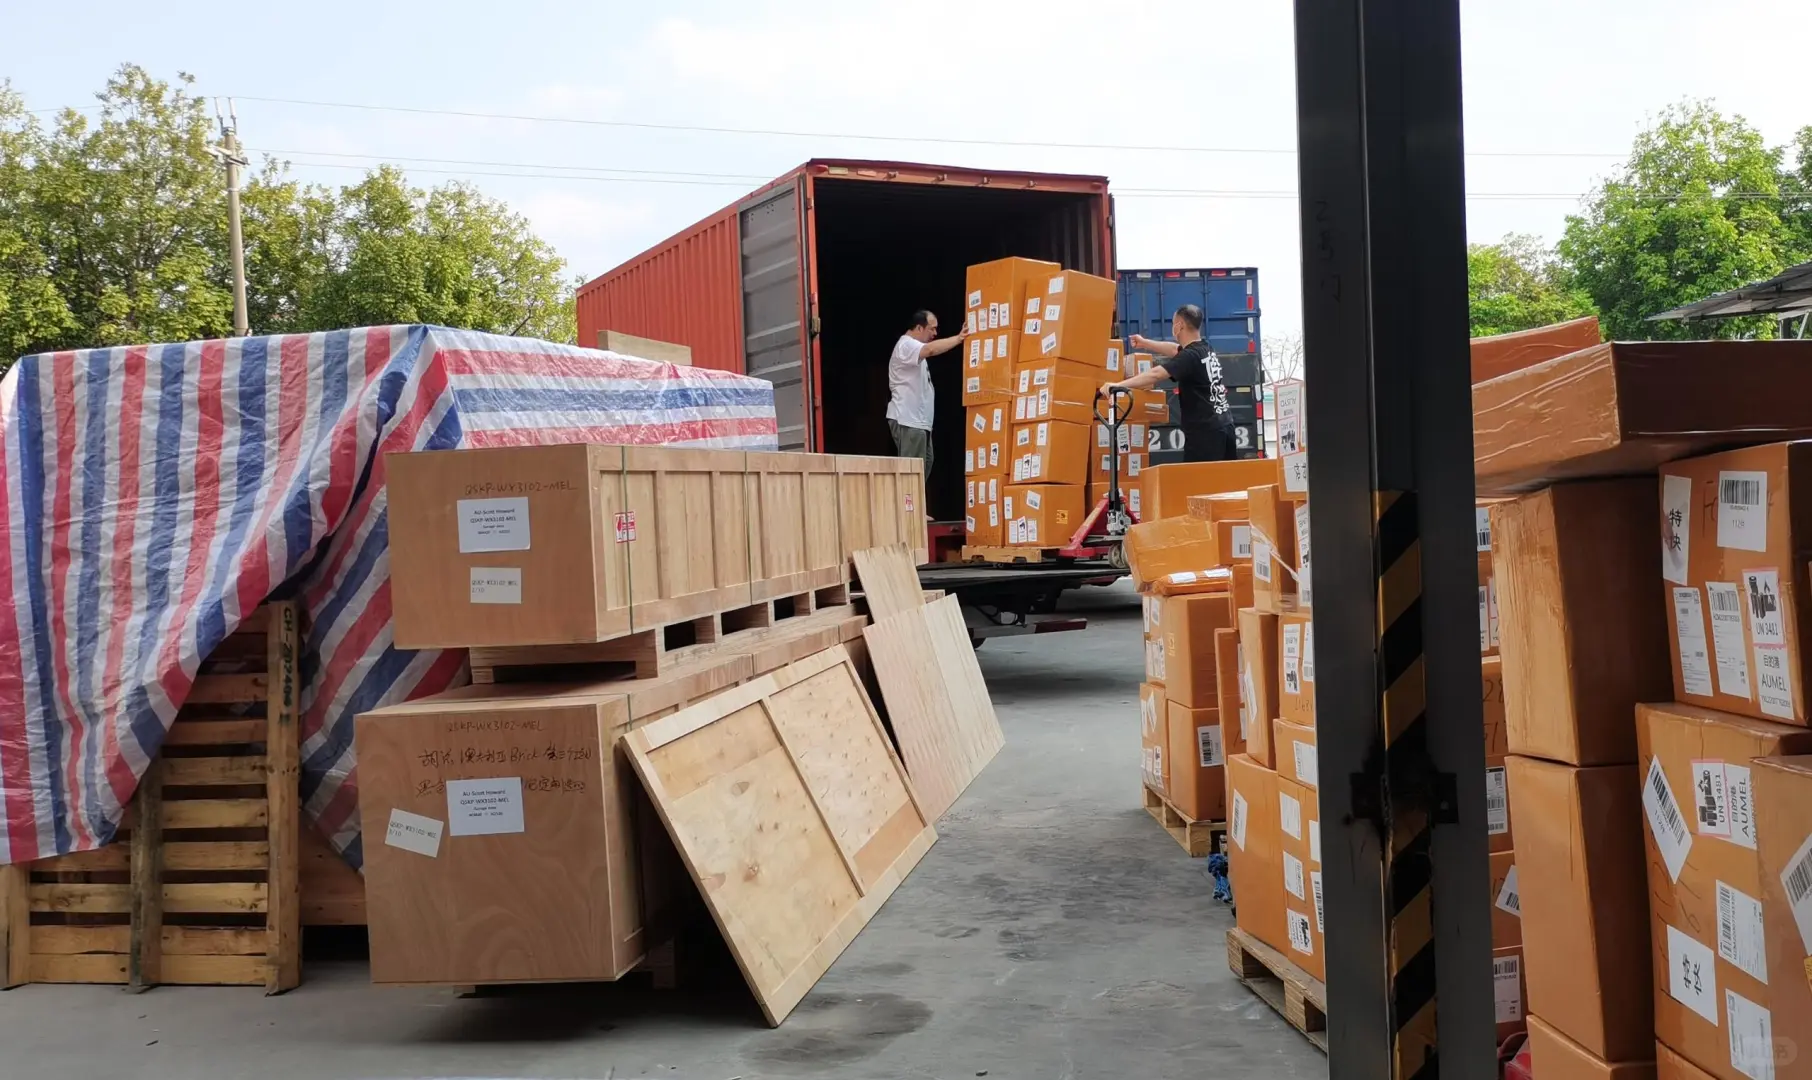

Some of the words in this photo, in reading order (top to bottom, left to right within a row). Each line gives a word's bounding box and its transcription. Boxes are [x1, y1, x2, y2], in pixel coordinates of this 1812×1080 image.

[1755, 622, 1764, 636] UN
[1764, 622, 1779, 637] 3481
[1761, 674, 1787, 692] AUMEL
[1714, 774, 1724, 804] 3481
[1717, 805, 1726, 823] UN
[1738, 777, 1750, 839] AUMEL
